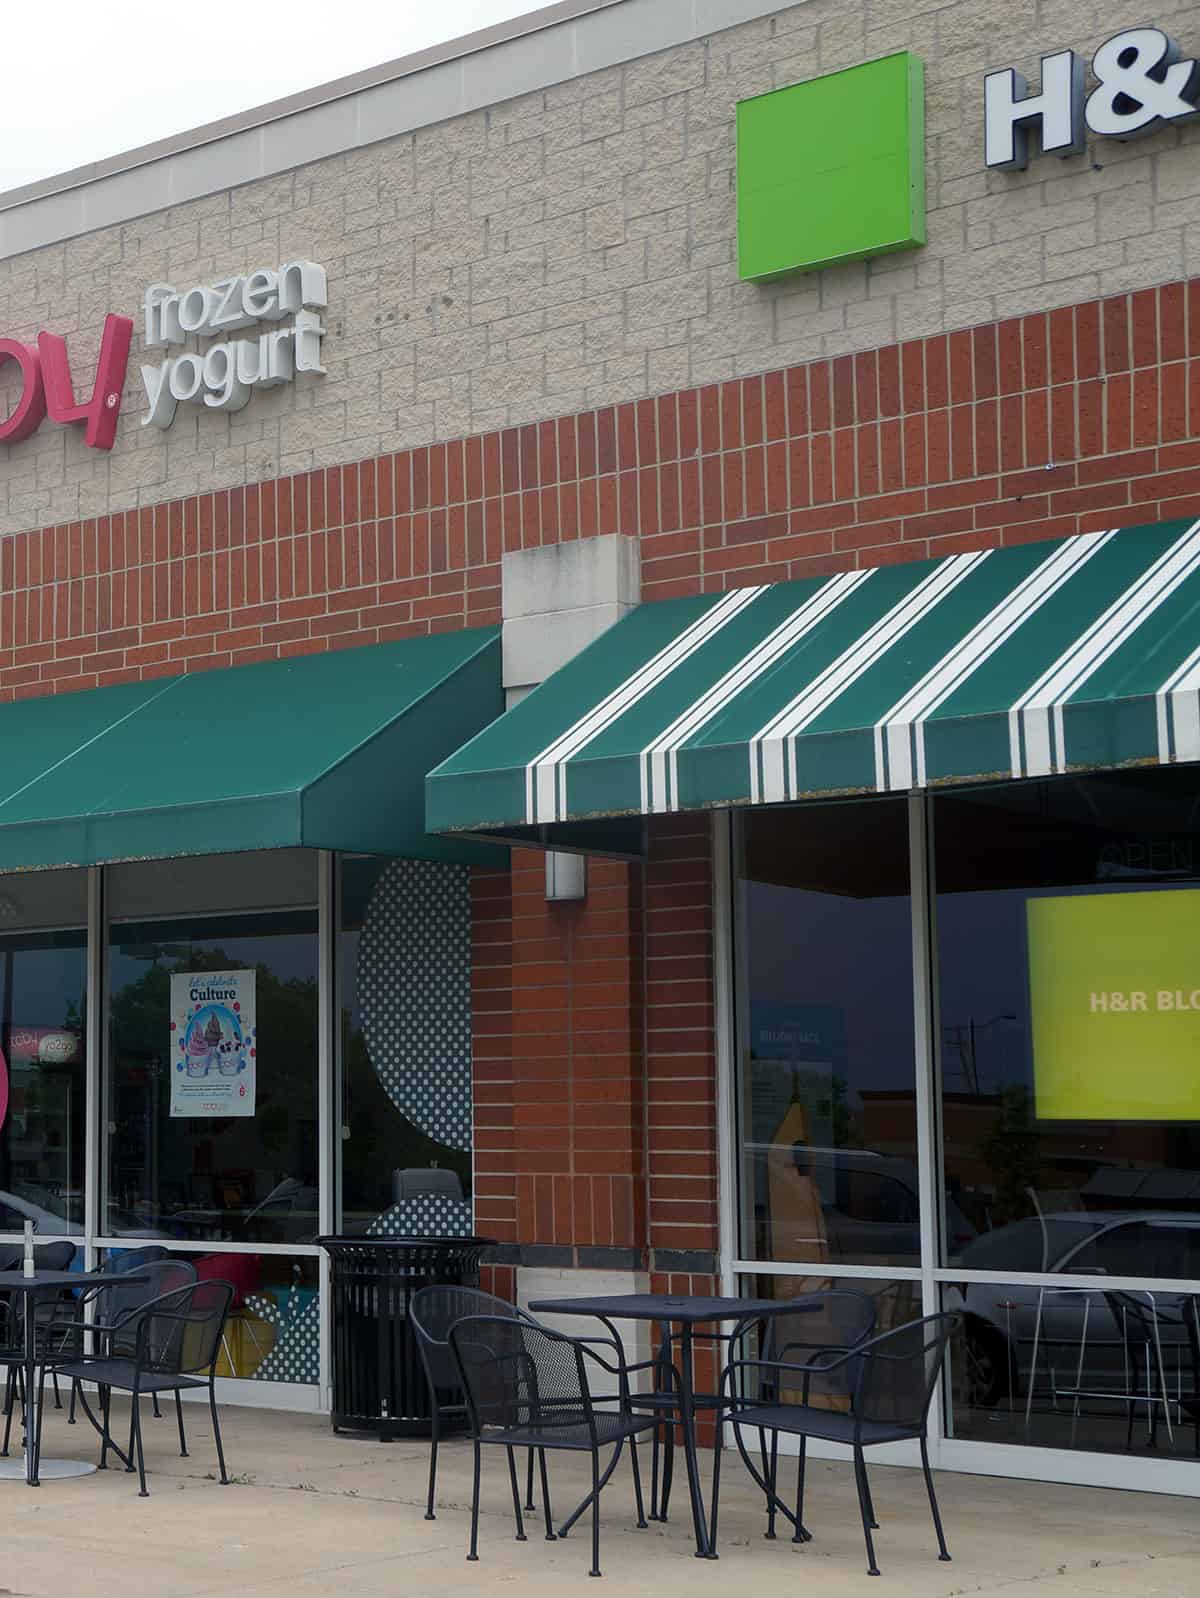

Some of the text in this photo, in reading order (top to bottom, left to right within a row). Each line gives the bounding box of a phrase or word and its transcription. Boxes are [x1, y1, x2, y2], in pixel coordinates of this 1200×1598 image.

[984, 27, 1200, 168] H&
[143, 260, 328, 346] frozen
[141, 310, 328, 430] yogurt
[189, 987, 237, 1001] Culture
[1090, 992, 1148, 1012] H&R
